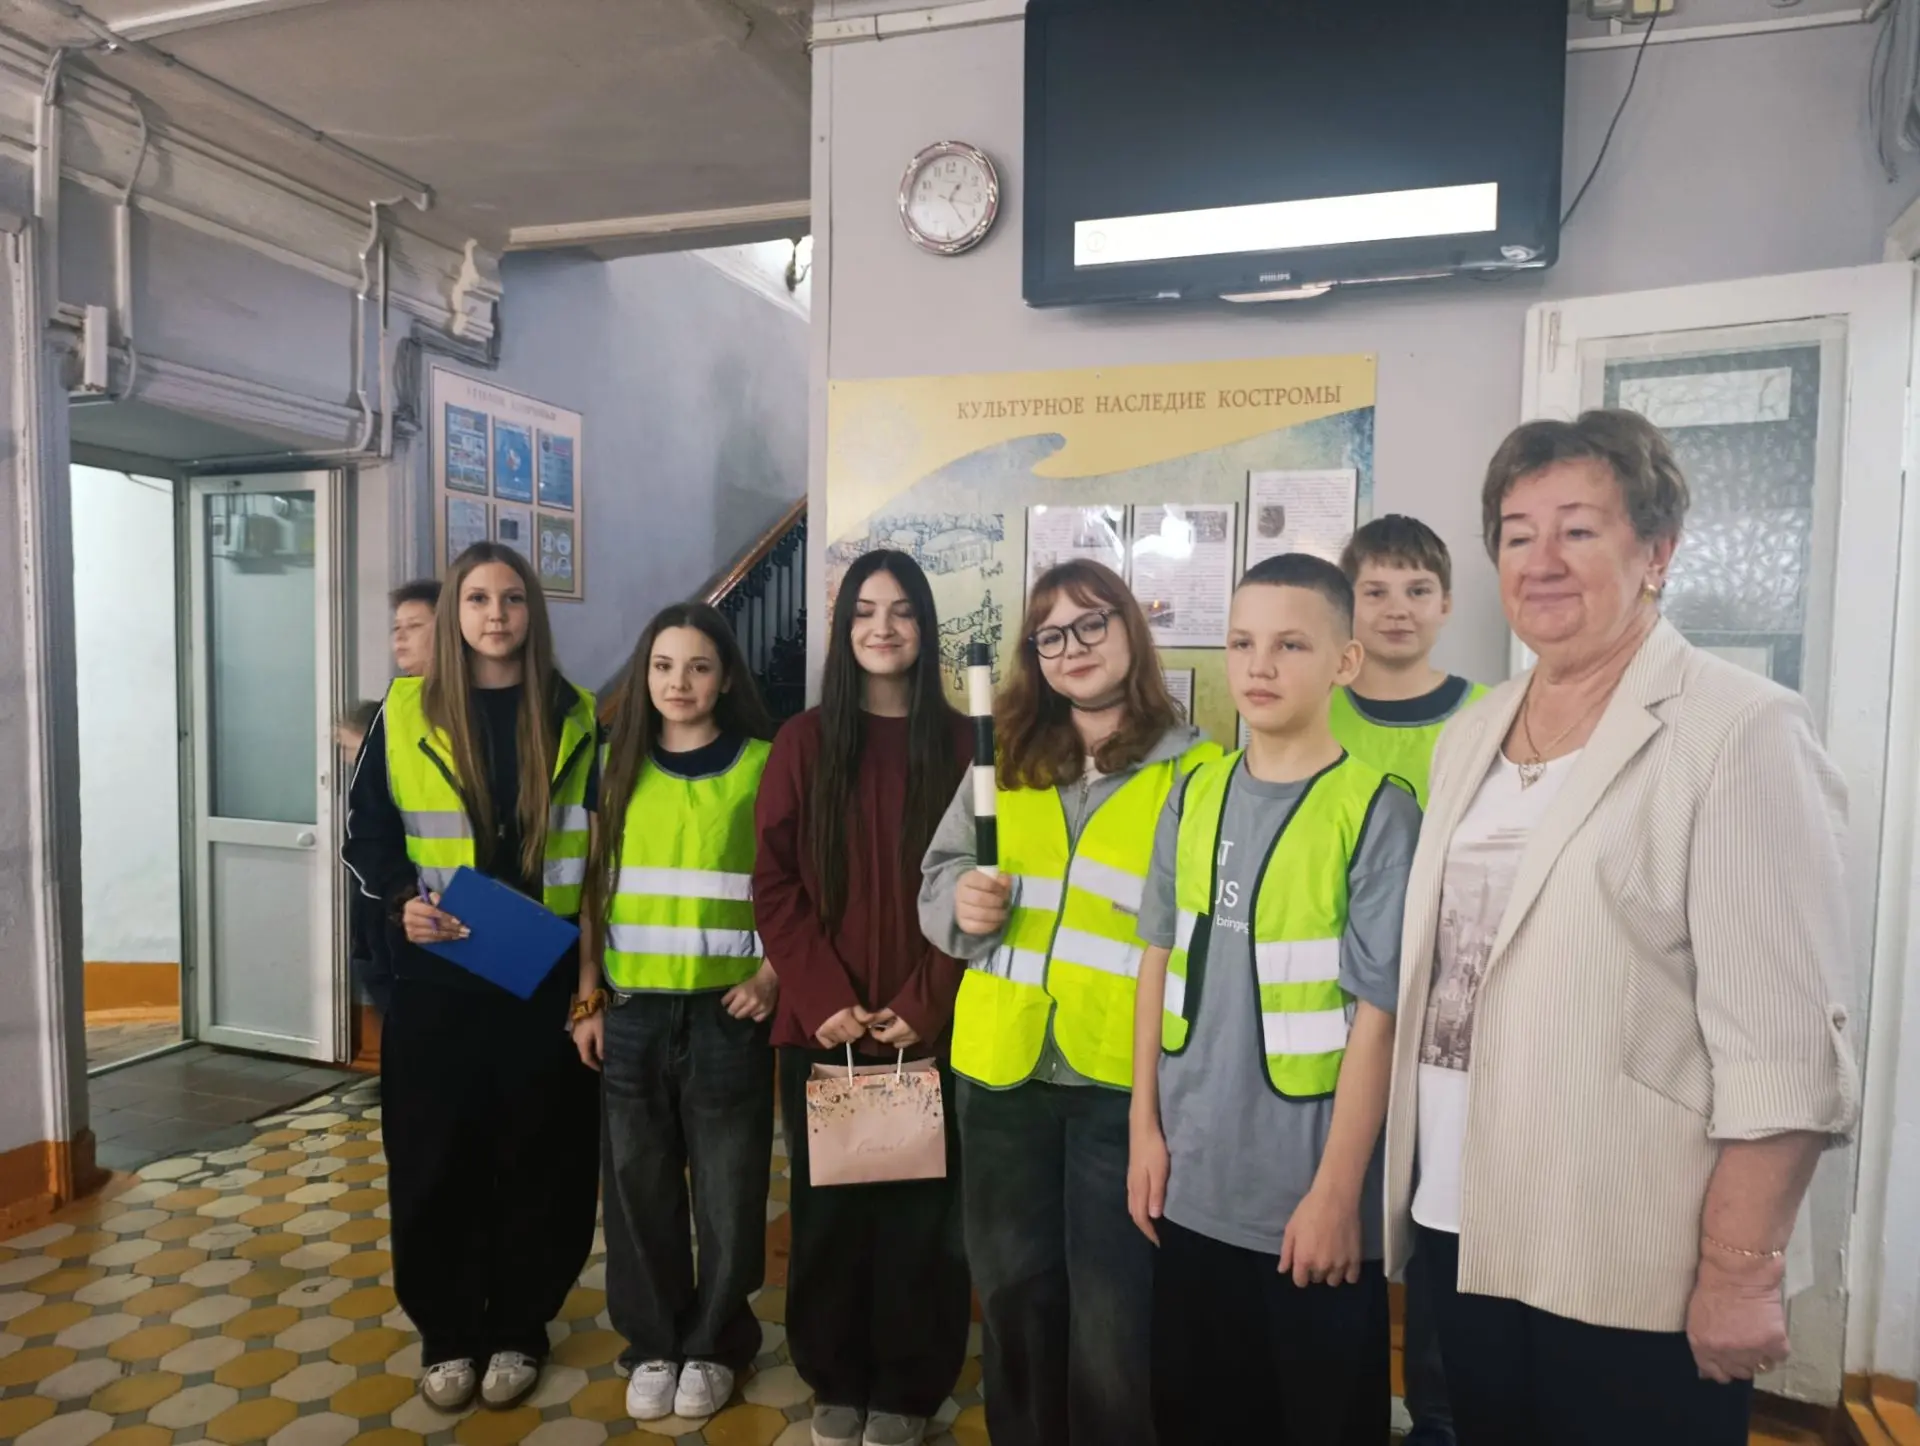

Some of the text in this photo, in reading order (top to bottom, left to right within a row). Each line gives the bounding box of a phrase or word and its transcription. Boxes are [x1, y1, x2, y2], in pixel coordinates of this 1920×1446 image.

[1260, 272, 1291, 282] PHILIPS
[957, 384, 1345, 419] КУЛЬТУРНОЕ НАСЛЕДИЕ КОСТРОМЫ
